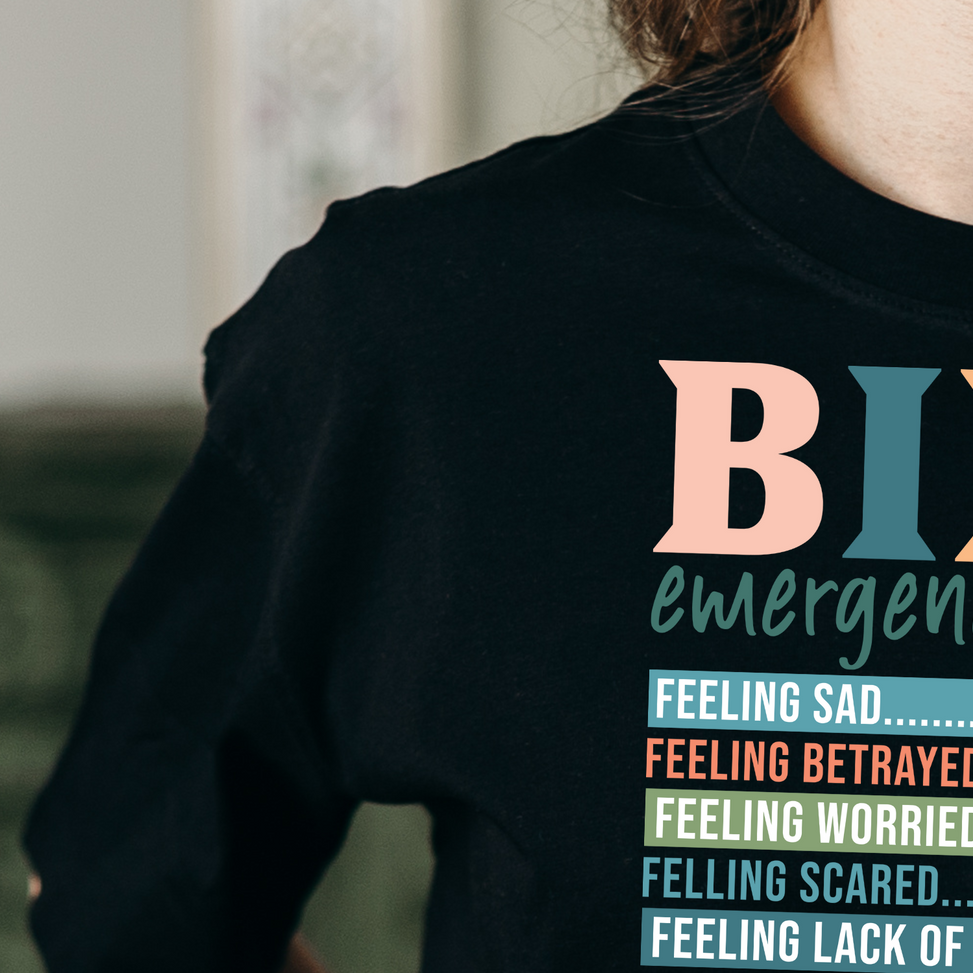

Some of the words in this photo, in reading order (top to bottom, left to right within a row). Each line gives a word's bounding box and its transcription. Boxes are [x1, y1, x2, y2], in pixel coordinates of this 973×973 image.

[656, 678, 800, 723] FEELING
[645, 737, 790, 783] FEELING
[655, 797, 803, 843] FEELING
[641, 856, 787, 902] FELLING
[652, 916, 799, 962] FEELING
[814, 921, 907, 965] LACK
[920, 924, 964, 967] OF
